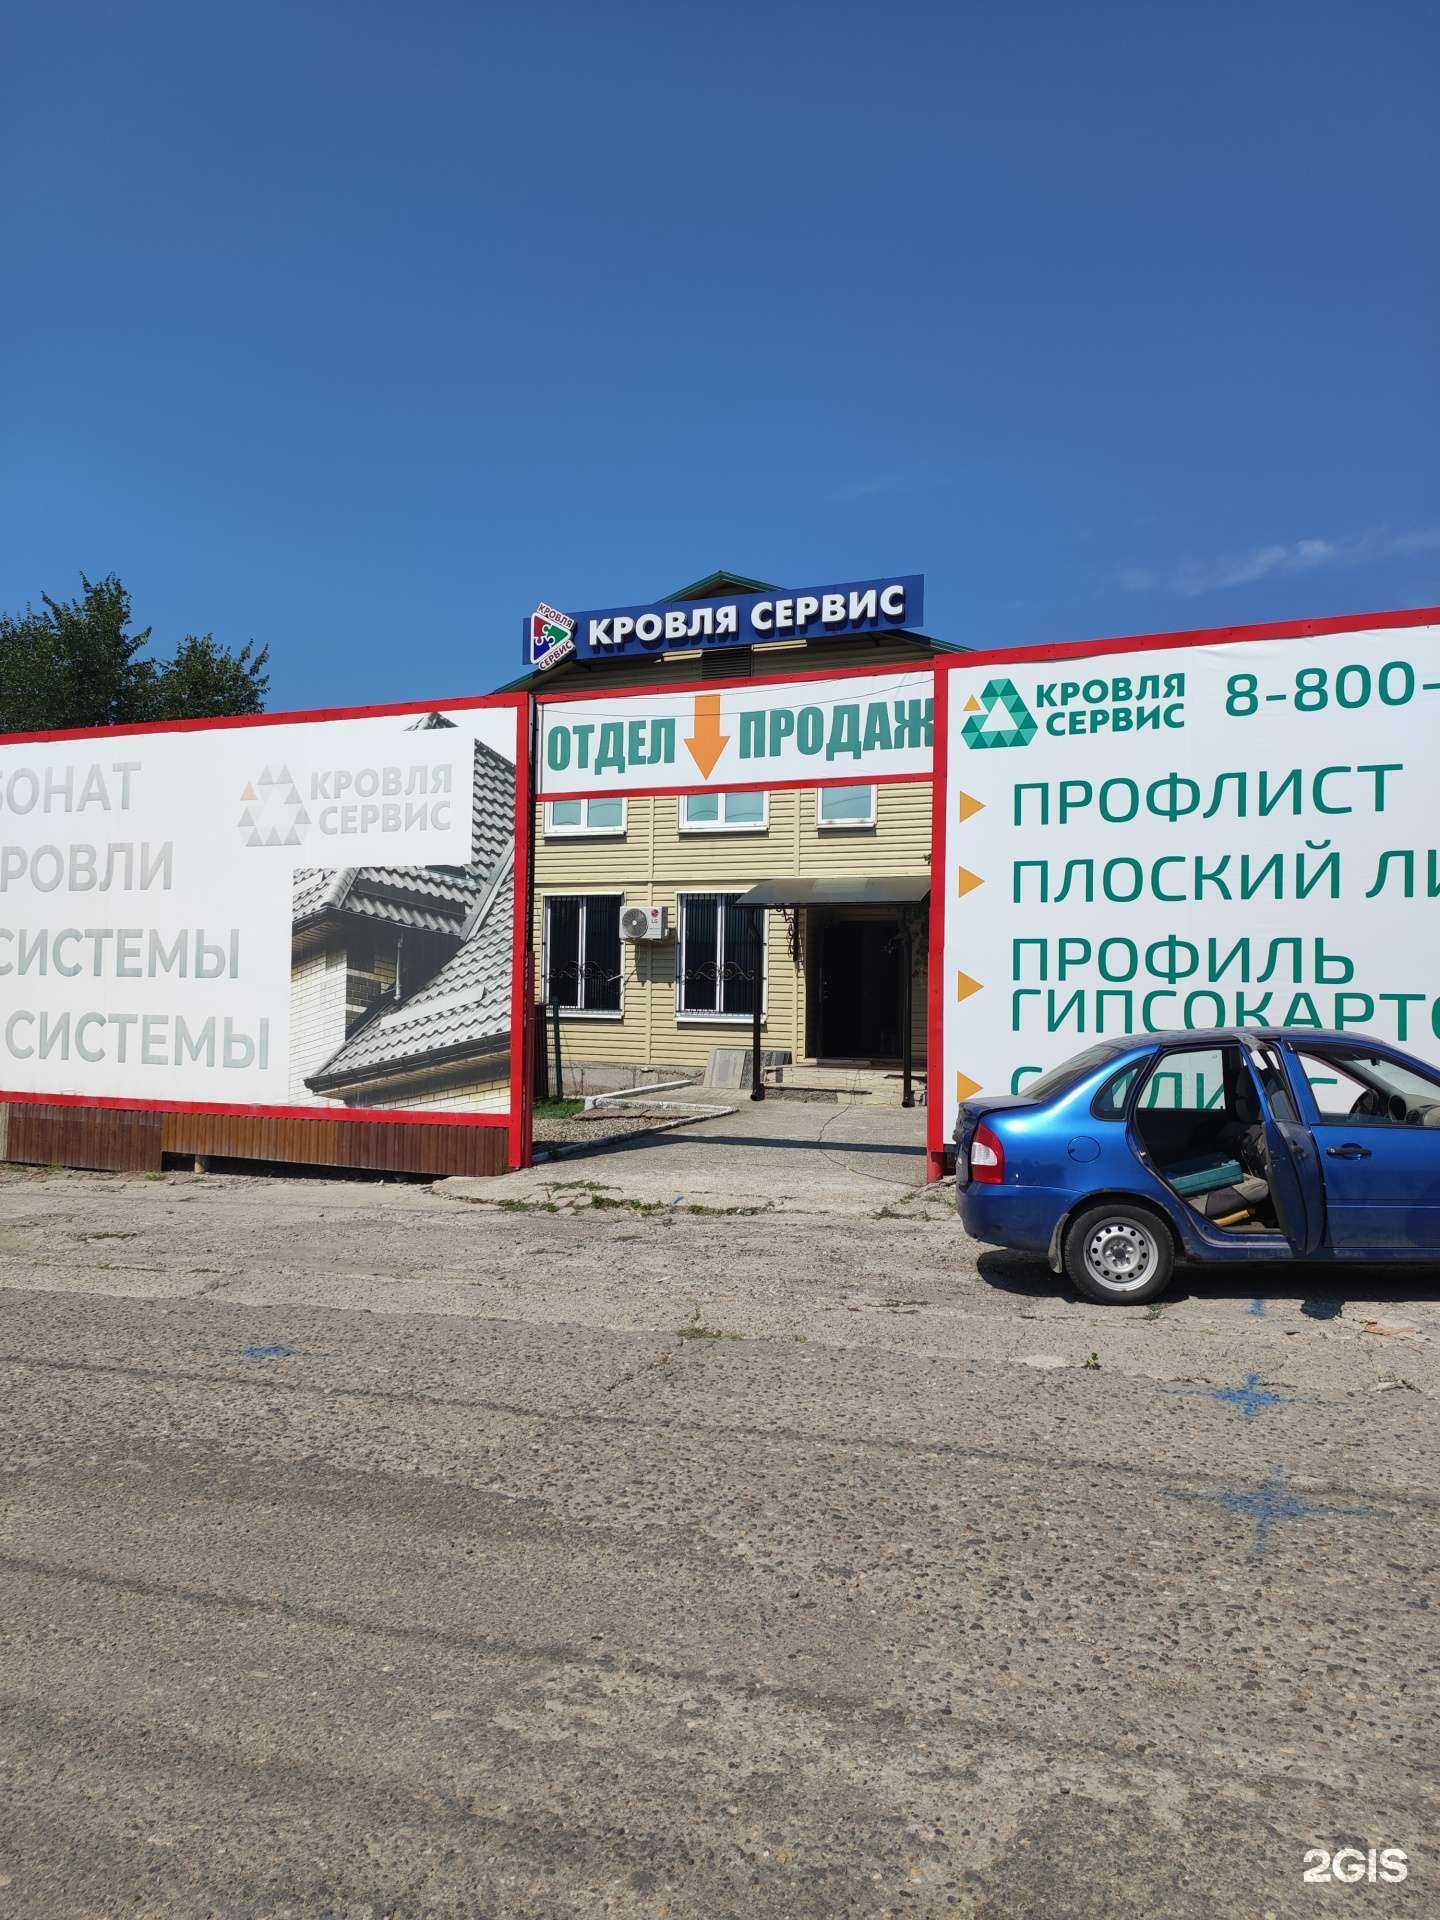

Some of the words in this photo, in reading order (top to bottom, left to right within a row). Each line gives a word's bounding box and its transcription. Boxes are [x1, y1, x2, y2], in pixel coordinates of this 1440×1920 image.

[539, 603, 573, 628] КРОВЛЯ
[588, 605, 738, 646] КРОВЛЯ
[750, 585, 904, 631] СЕРВИС
[540, 640, 573, 669] СЕРВИС
[1036, 672, 1185, 708] КРОВЛЯ
[547, 718, 676, 775] ОТДЕЛ
[739, 697, 934, 761] ПРОДАЖ
[1045, 702, 1185, 737] СЕРВИС
[0, 761, 142, 815] ОНАТ
[310, 764, 453, 800] КРОВЛЯ
[1013, 763, 1403, 826] ПРОФЛИСТ
[318, 800, 451, 835] СЕРВИС
[1012, 839, 1340, 904] ПЛОСКИЙ
[1012, 934, 1355, 985] ПРОФИЛЬ
[5, 1009, 270, 1070] СИСТЕМЫ
[1011, 988, 1440, 1042] ГИПСОКАРТ
